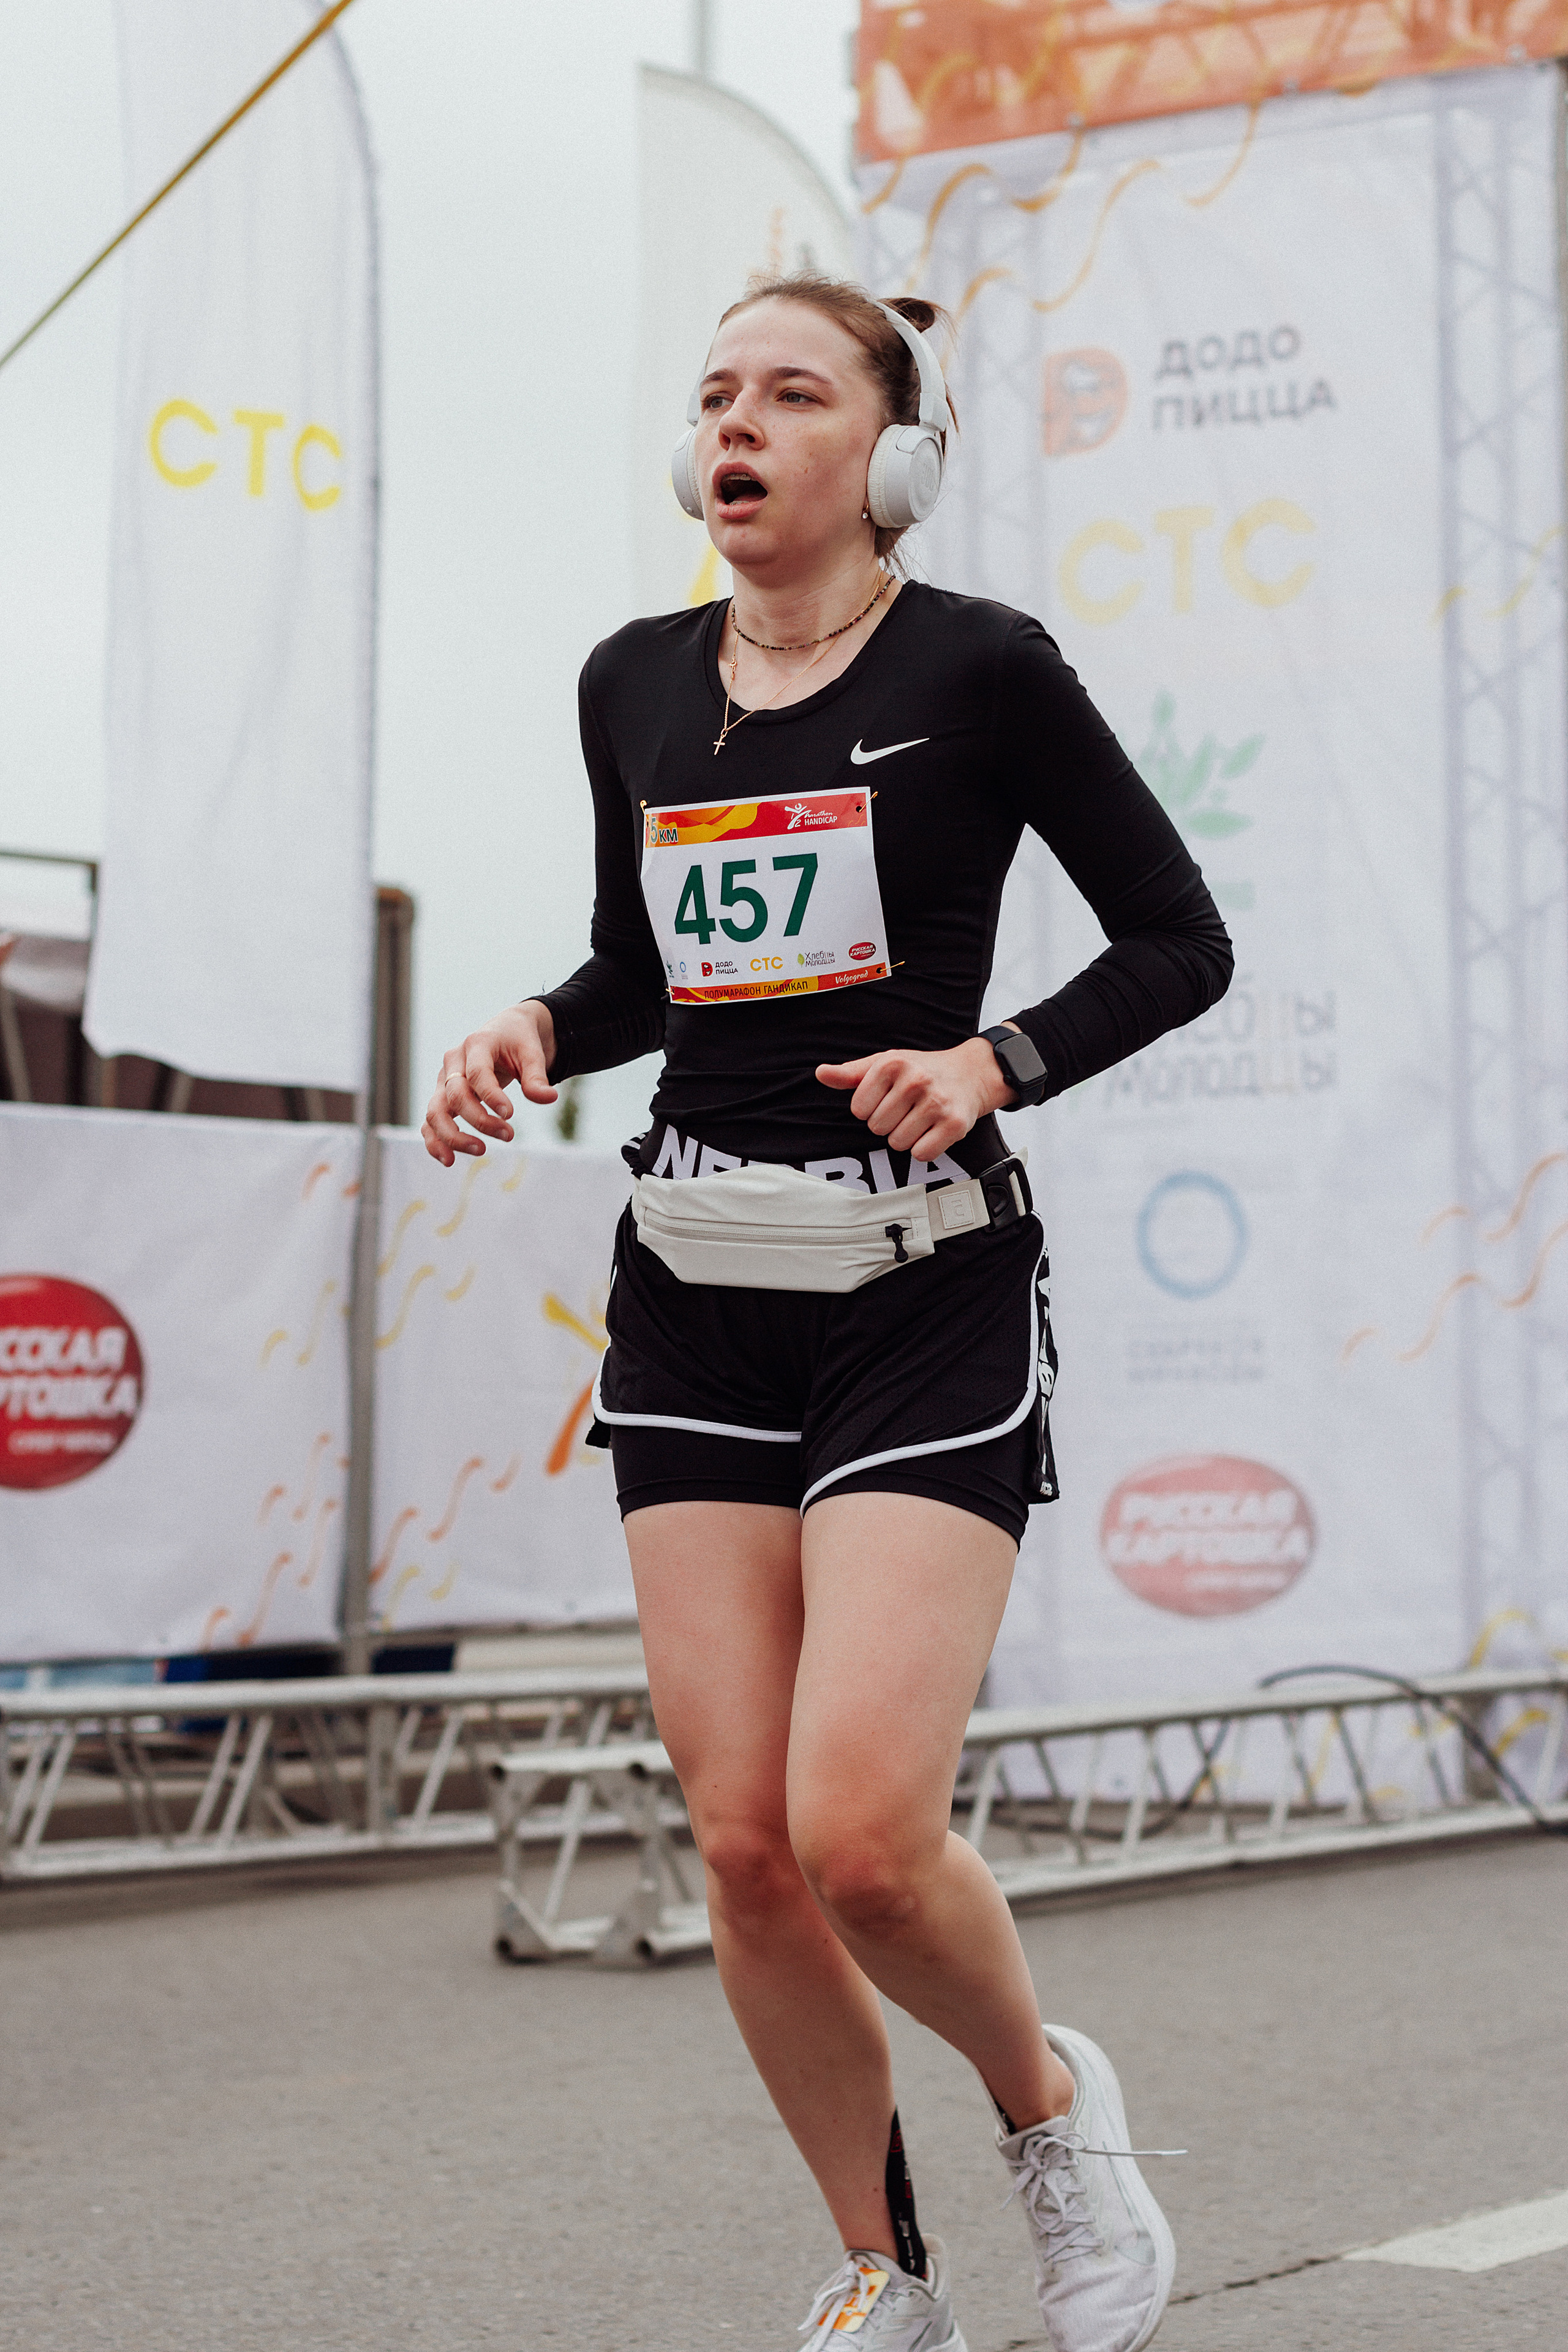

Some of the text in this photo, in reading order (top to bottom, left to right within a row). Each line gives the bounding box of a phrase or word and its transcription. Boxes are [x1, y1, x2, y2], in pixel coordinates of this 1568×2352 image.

[1154, 325, 1303, 382] ДОДО
[1152, 377, 1339, 431] ПИЦЦА
[149, 399, 342, 511] СТС
[1058, 498, 1318, 626] СТС
[650, 817, 658, 843] 5
[805, 816, 837, 826] HANDICAP
[674, 853, 818, 944] 457
[750, 957, 783, 971] СТС
[835, 970, 869, 985] Volgograd
[704, 981, 809, 999] ПОЛУМАРАФОН ГАНДИКАП
[652, 1123, 972, 1195] NEBIA
[0, 1325, 128, 1374] ССКАЯ
